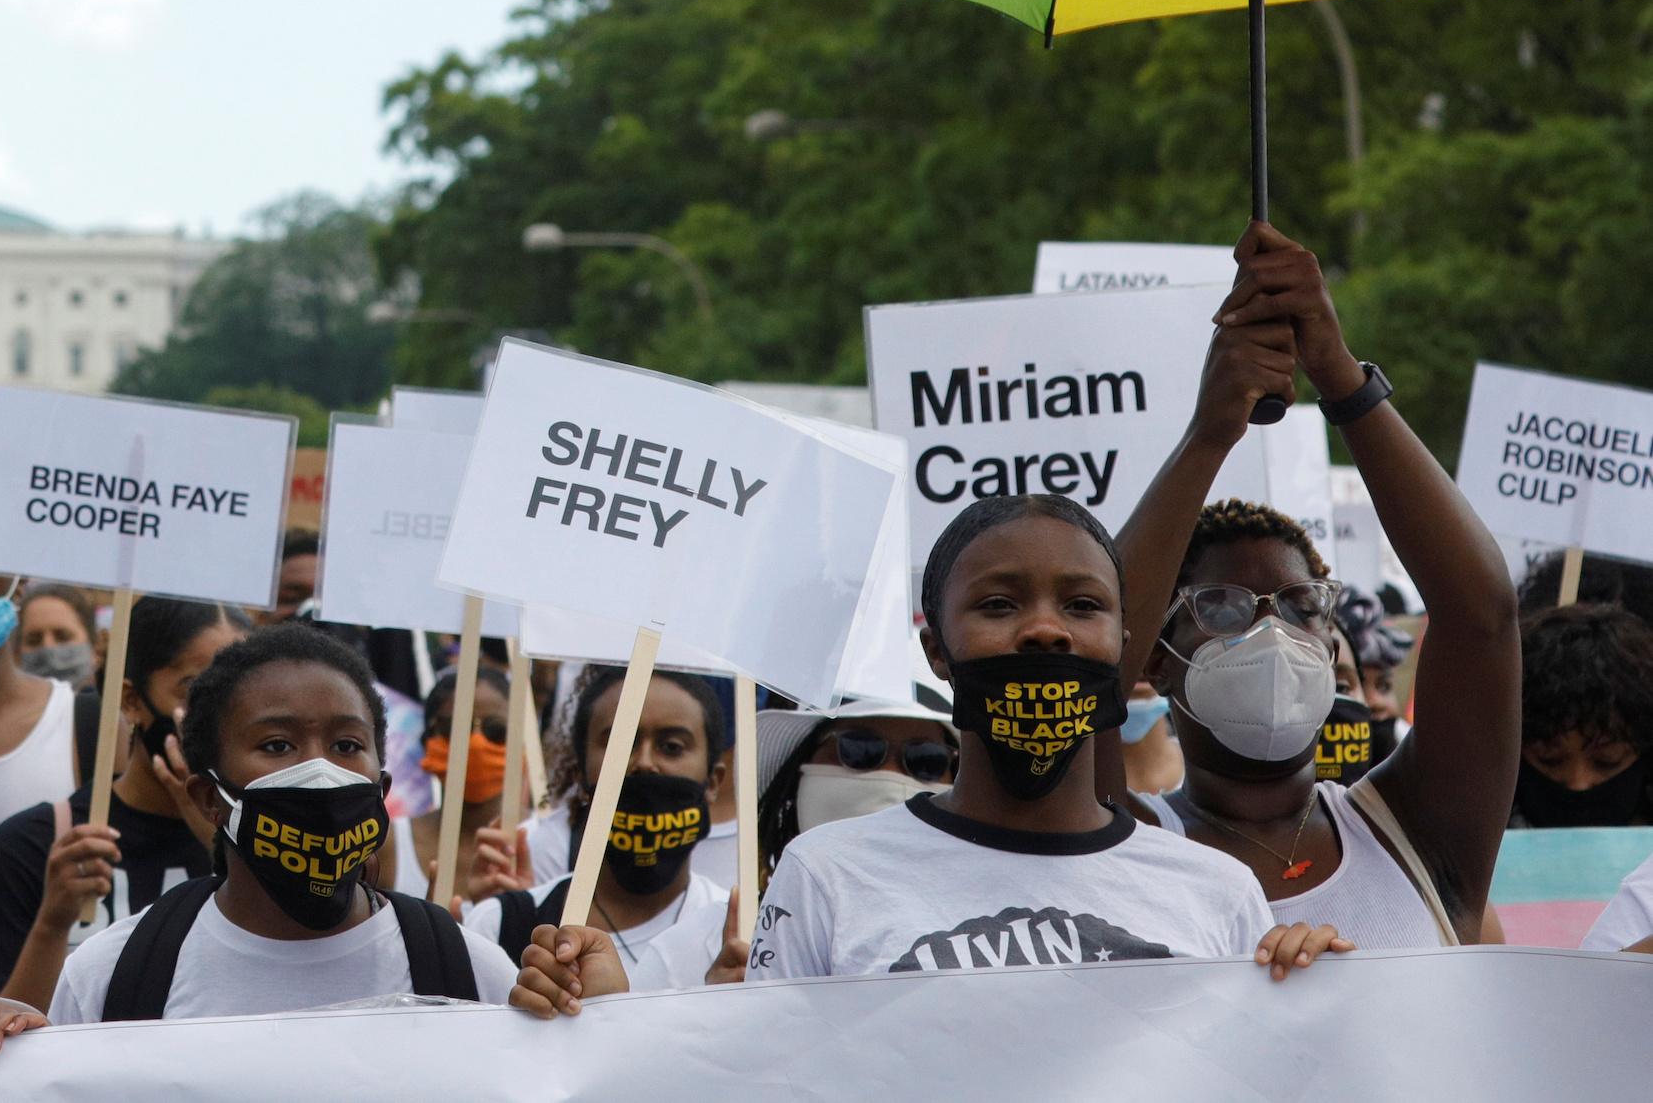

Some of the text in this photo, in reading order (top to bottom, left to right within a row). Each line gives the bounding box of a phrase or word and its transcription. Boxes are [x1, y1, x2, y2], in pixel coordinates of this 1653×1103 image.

[1059, 271, 1170, 290] LATANYA
[910, 363, 1146, 428] Miriam
[541, 420, 768, 517] SHELLY
[915, 445, 1118, 506] Carey
[1498, 472, 1578, 506] CULP
[29, 465, 161, 506] BRENDA
[170, 484, 250, 517] FAYE
[525, 476, 690, 548] FREY
[25, 497, 161, 539] COOPER
[985, 695, 1098, 719] KILLING
[1004, 680, 1081, 700] STOP
[991, 715, 1094, 739] BLACK
[1323, 721, 1370, 742] UND
[255, 813, 380, 856] DEFUND
[609, 827, 700, 854] OLICE
[253, 837, 378, 881] POLICE
